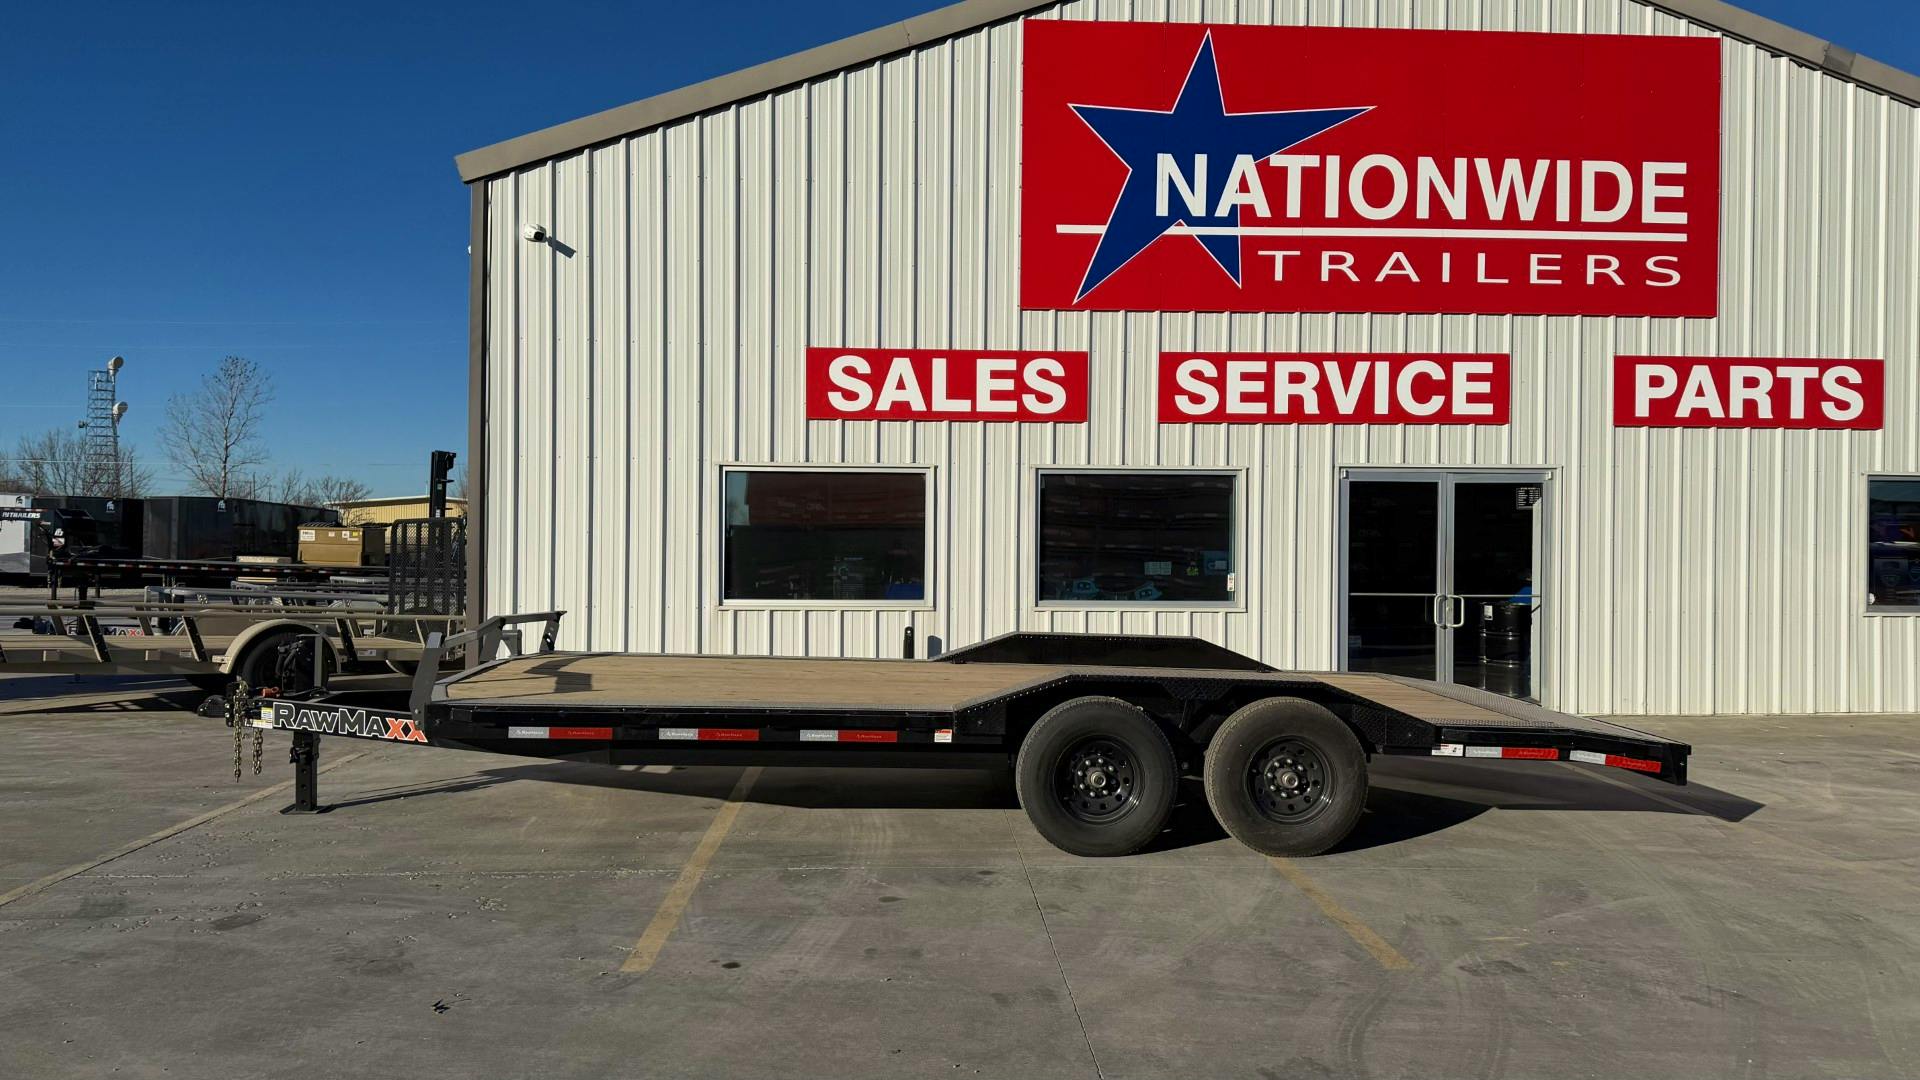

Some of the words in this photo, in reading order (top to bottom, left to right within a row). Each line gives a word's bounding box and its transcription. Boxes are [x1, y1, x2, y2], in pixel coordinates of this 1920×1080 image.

[1155, 152, 1688, 225] NATIONWIDE
[1257, 250, 1681, 287] TRAILERS
[827, 355, 1067, 415] SALES
[1174, 359, 1494, 416] SERVICE
[1634, 364, 1865, 421] PARTS
